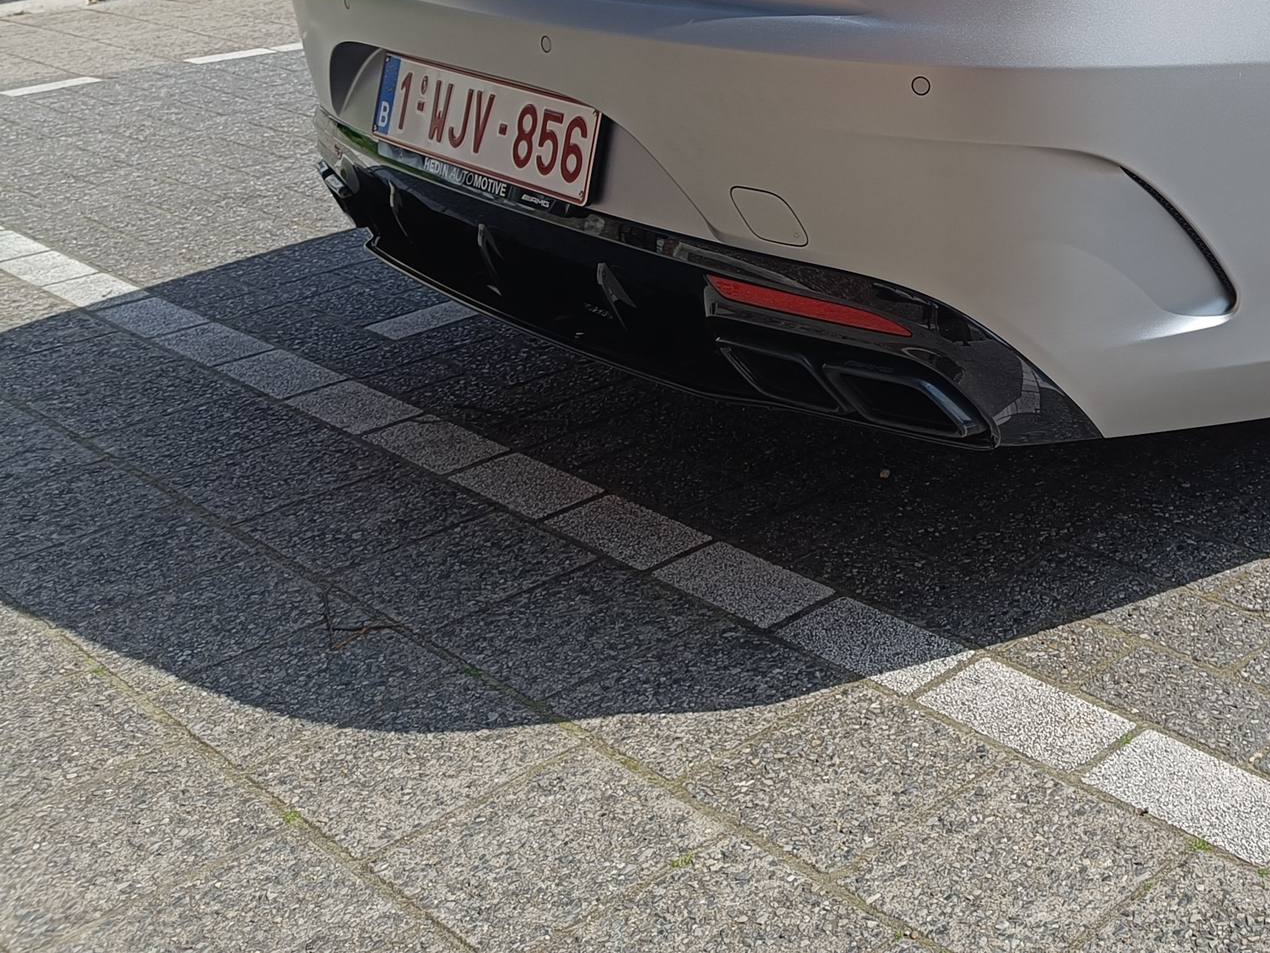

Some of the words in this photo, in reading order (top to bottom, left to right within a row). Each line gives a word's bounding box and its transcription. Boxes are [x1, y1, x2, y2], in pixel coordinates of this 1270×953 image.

[378, 101, 390, 127] B
[398, 72, 588, 183] 1-WJV-856
[423, 157, 448, 178] HEDIN
[450, 168, 507, 197] AUTOMOTIVE
[527, 195, 550, 208] AMG
